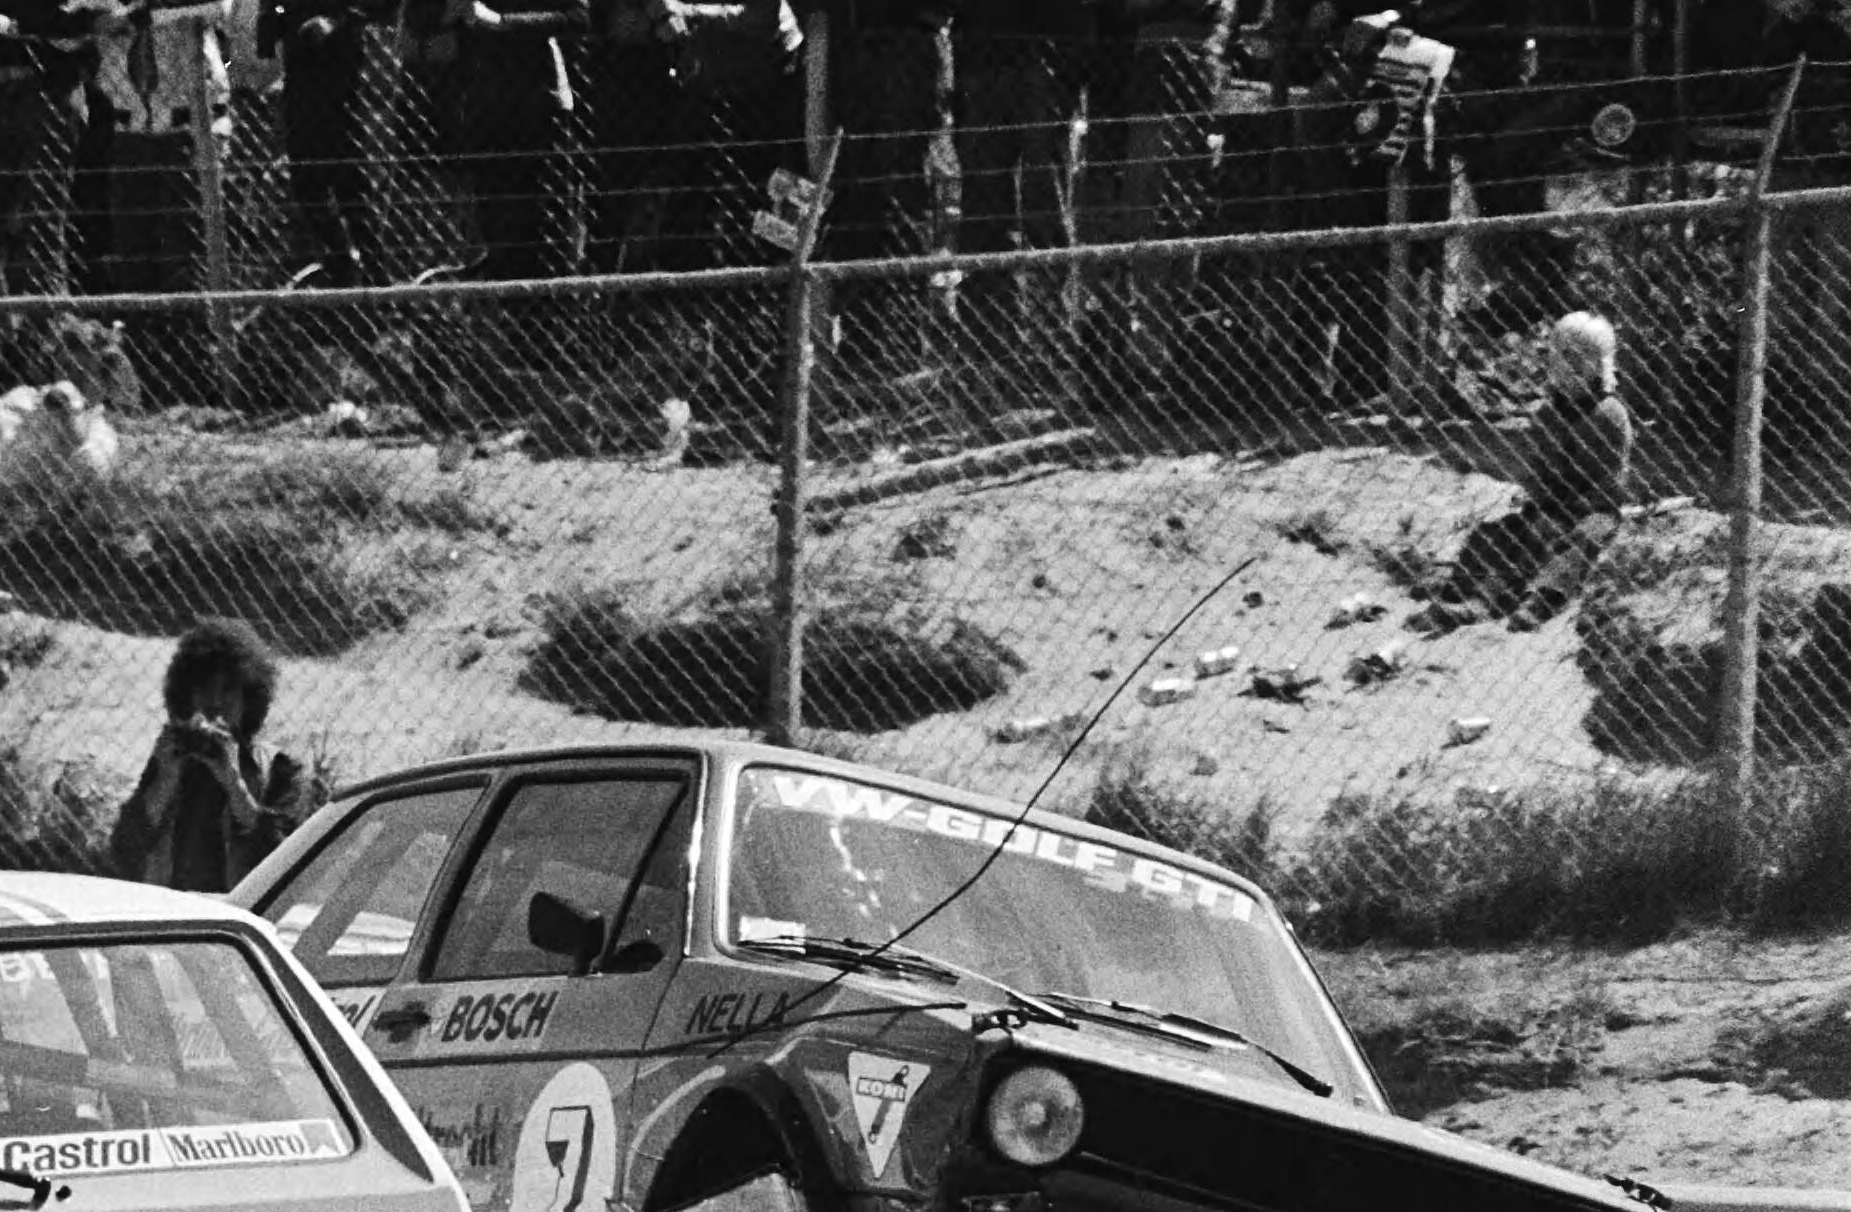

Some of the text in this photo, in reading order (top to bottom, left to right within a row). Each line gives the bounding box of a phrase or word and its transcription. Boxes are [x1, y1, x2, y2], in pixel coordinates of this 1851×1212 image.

[1130, 856, 1253, 922] GTI
[441, 991, 558, 1042] BOSCH
[684, 992, 791, 1034] NELLA
[3, 1134, 151, 1177] Castrol
[167, 1128, 305, 1163] Marlboro
